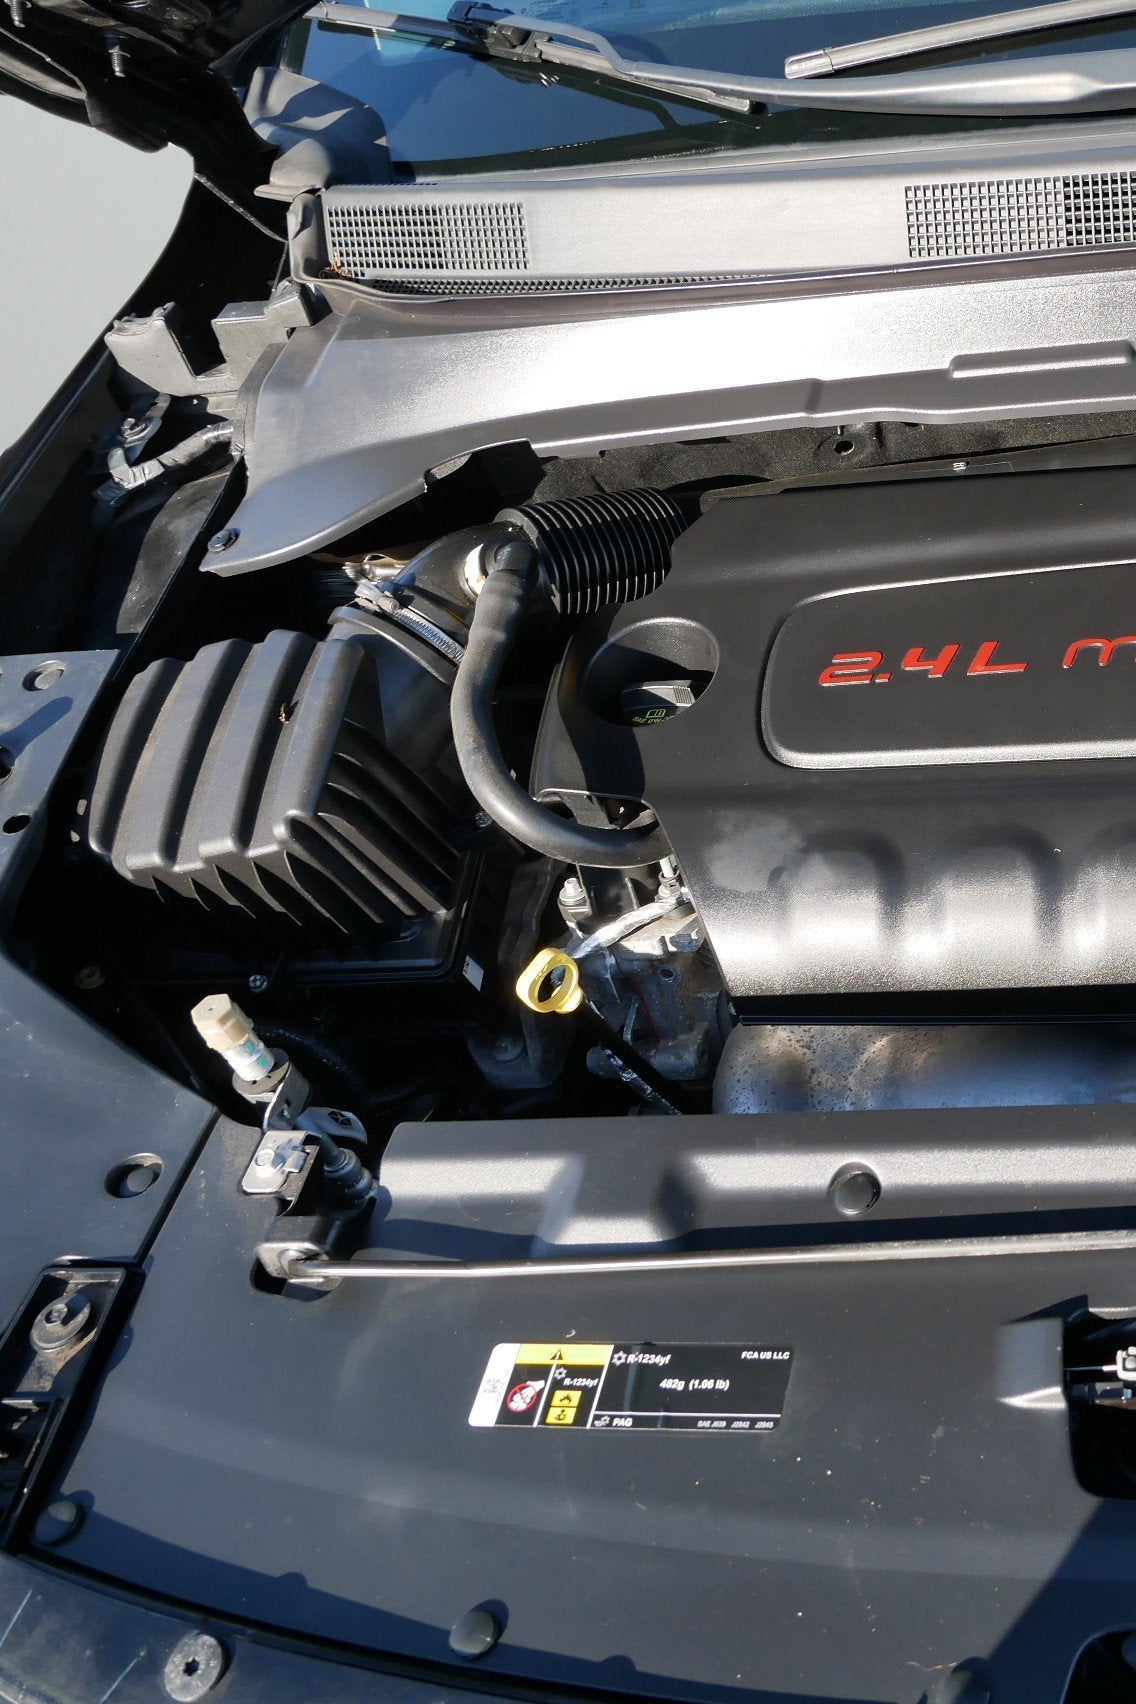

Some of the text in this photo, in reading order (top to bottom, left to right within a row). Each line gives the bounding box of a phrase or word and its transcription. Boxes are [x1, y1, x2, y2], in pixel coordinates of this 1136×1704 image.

[818, 640, 1029, 687] 2.4L
[627, 1353, 671, 1366] R-1234yf
[741, 1351, 790, 1360] FCA US LLC
[563, 1377, 599, 1387] R-1234yf
[659, 1378, 685, 1391] 482g
[715, 1379, 730, 1391] lb)
[612, 1417, 633, 1427] PAG
